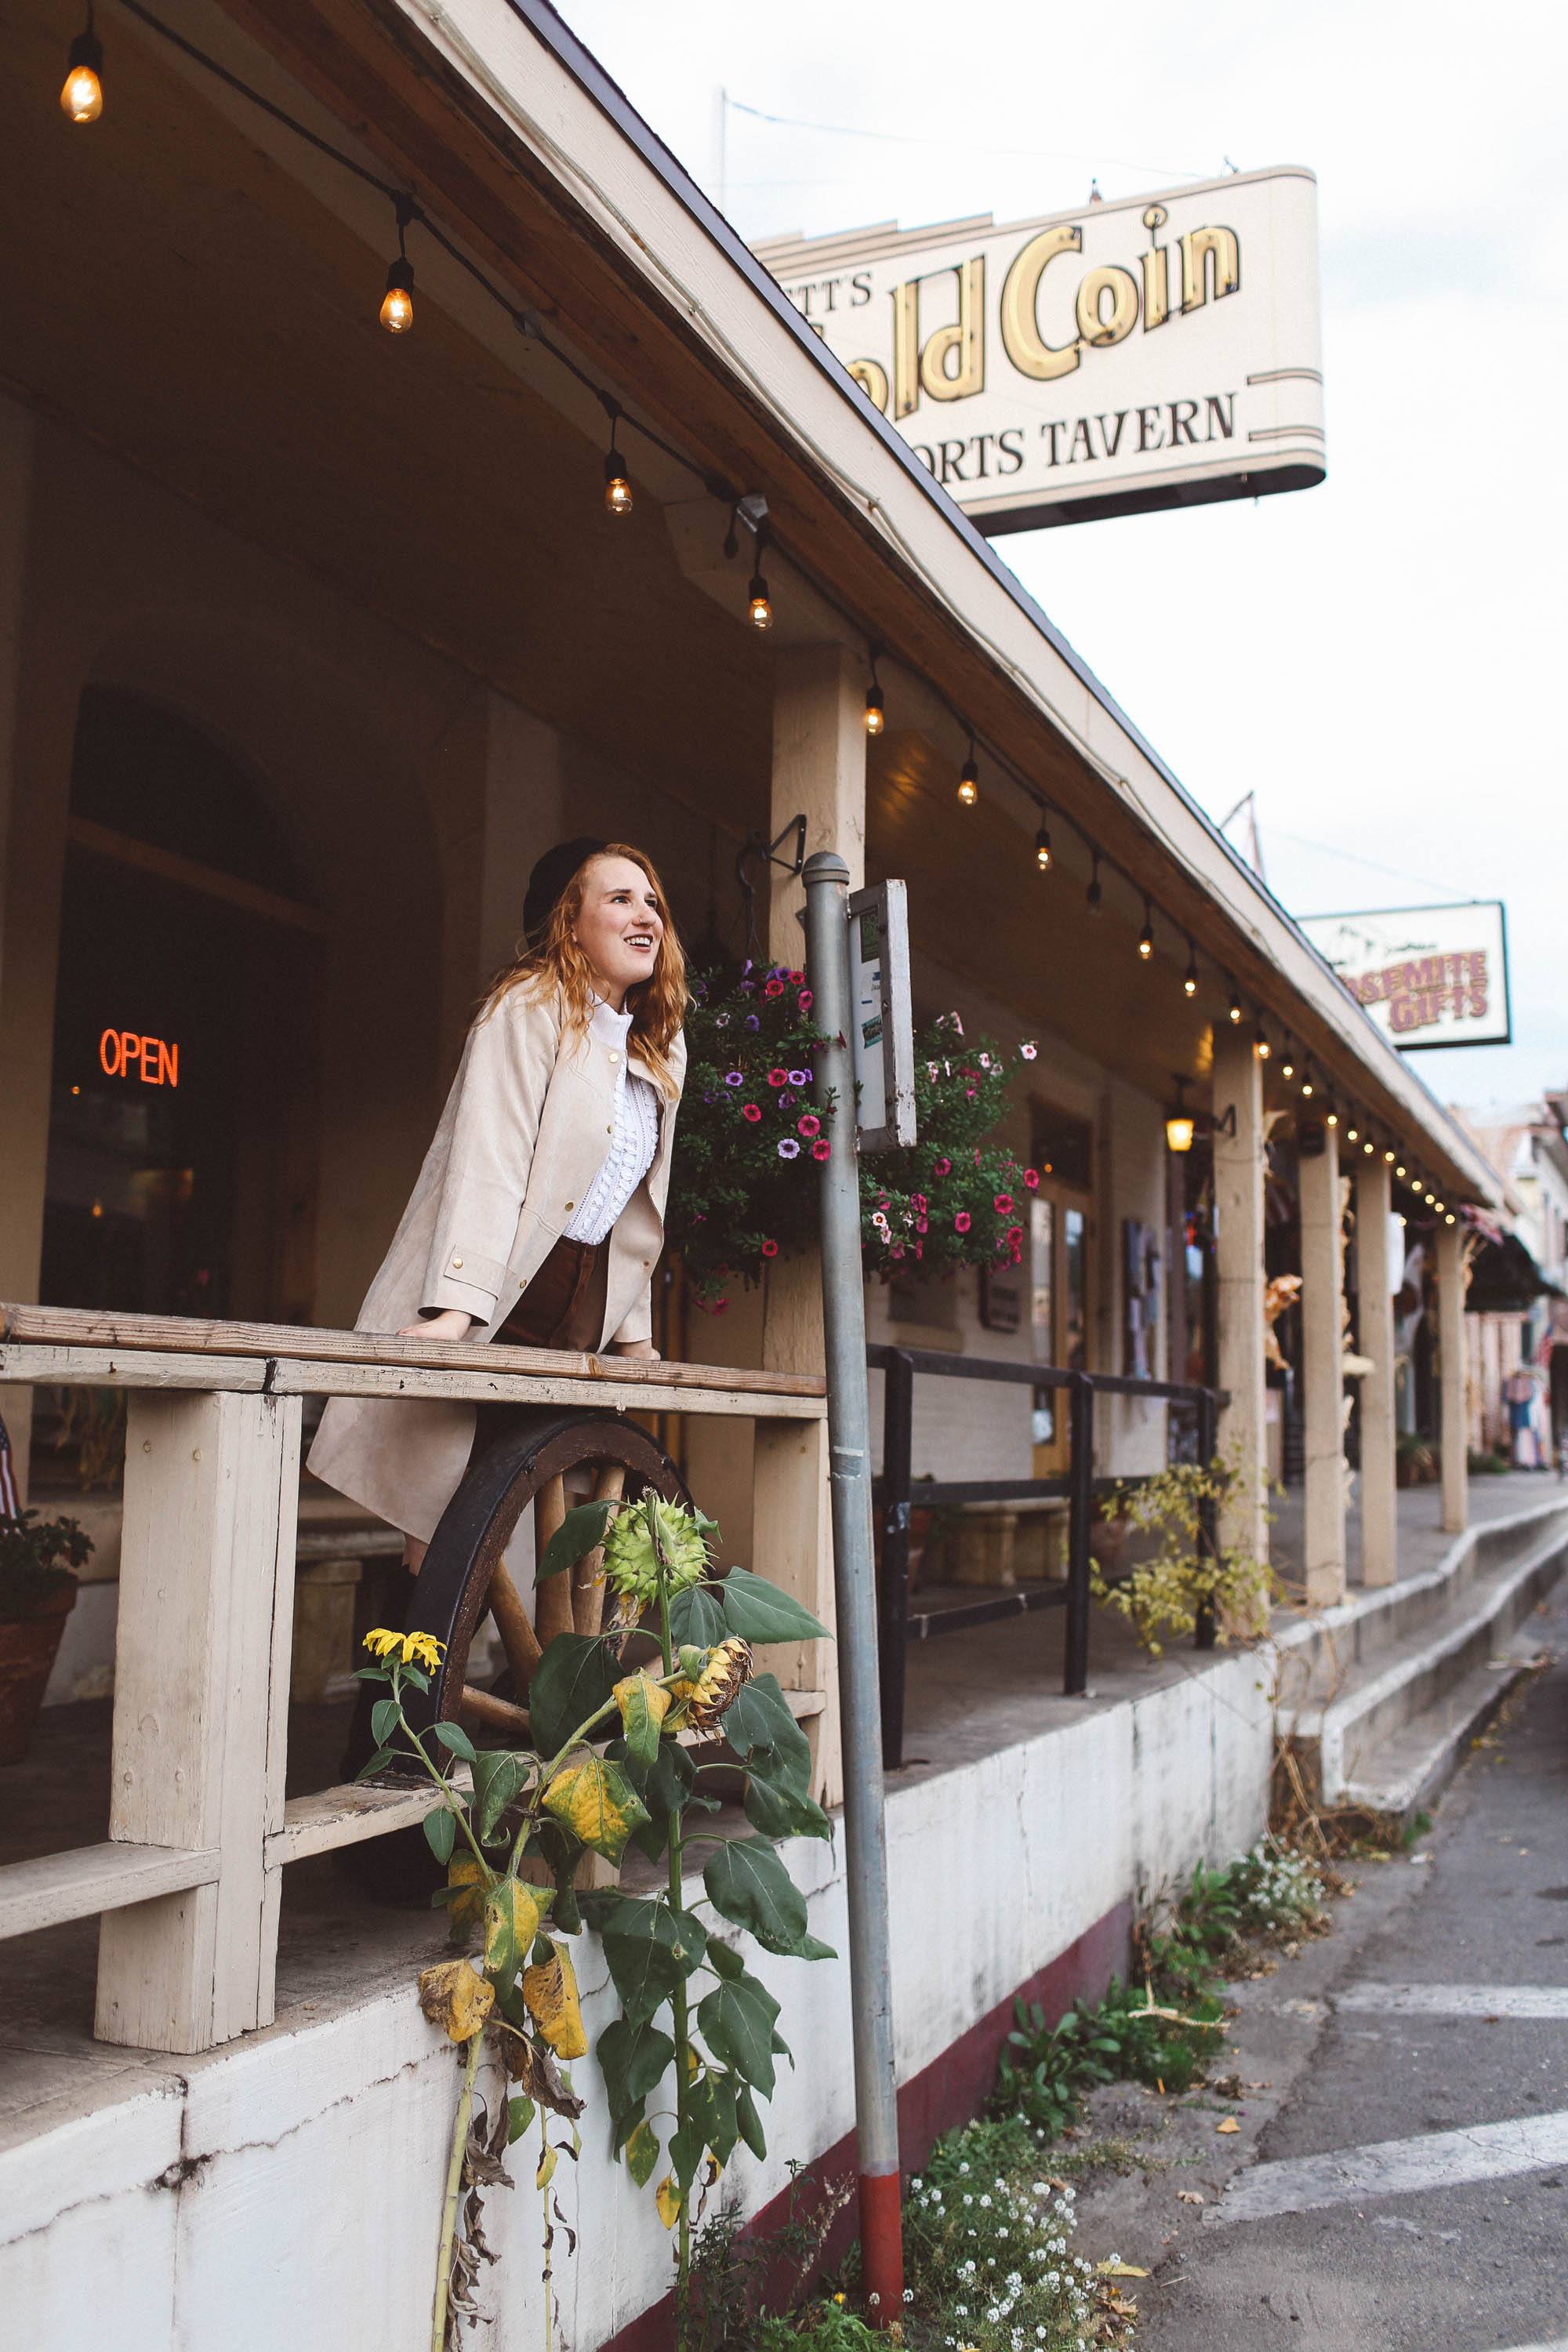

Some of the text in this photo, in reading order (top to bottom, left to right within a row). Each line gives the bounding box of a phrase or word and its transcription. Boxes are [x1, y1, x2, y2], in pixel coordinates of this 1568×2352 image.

[785, 272, 872, 315] TT'S
[810, 203, 1240, 422] old Coin
[913, 392, 1239, 483] ORTS TAVERN
[1388, 981, 1488, 1032] GIFTS
[100, 1029, 178, 1087] OPEN
